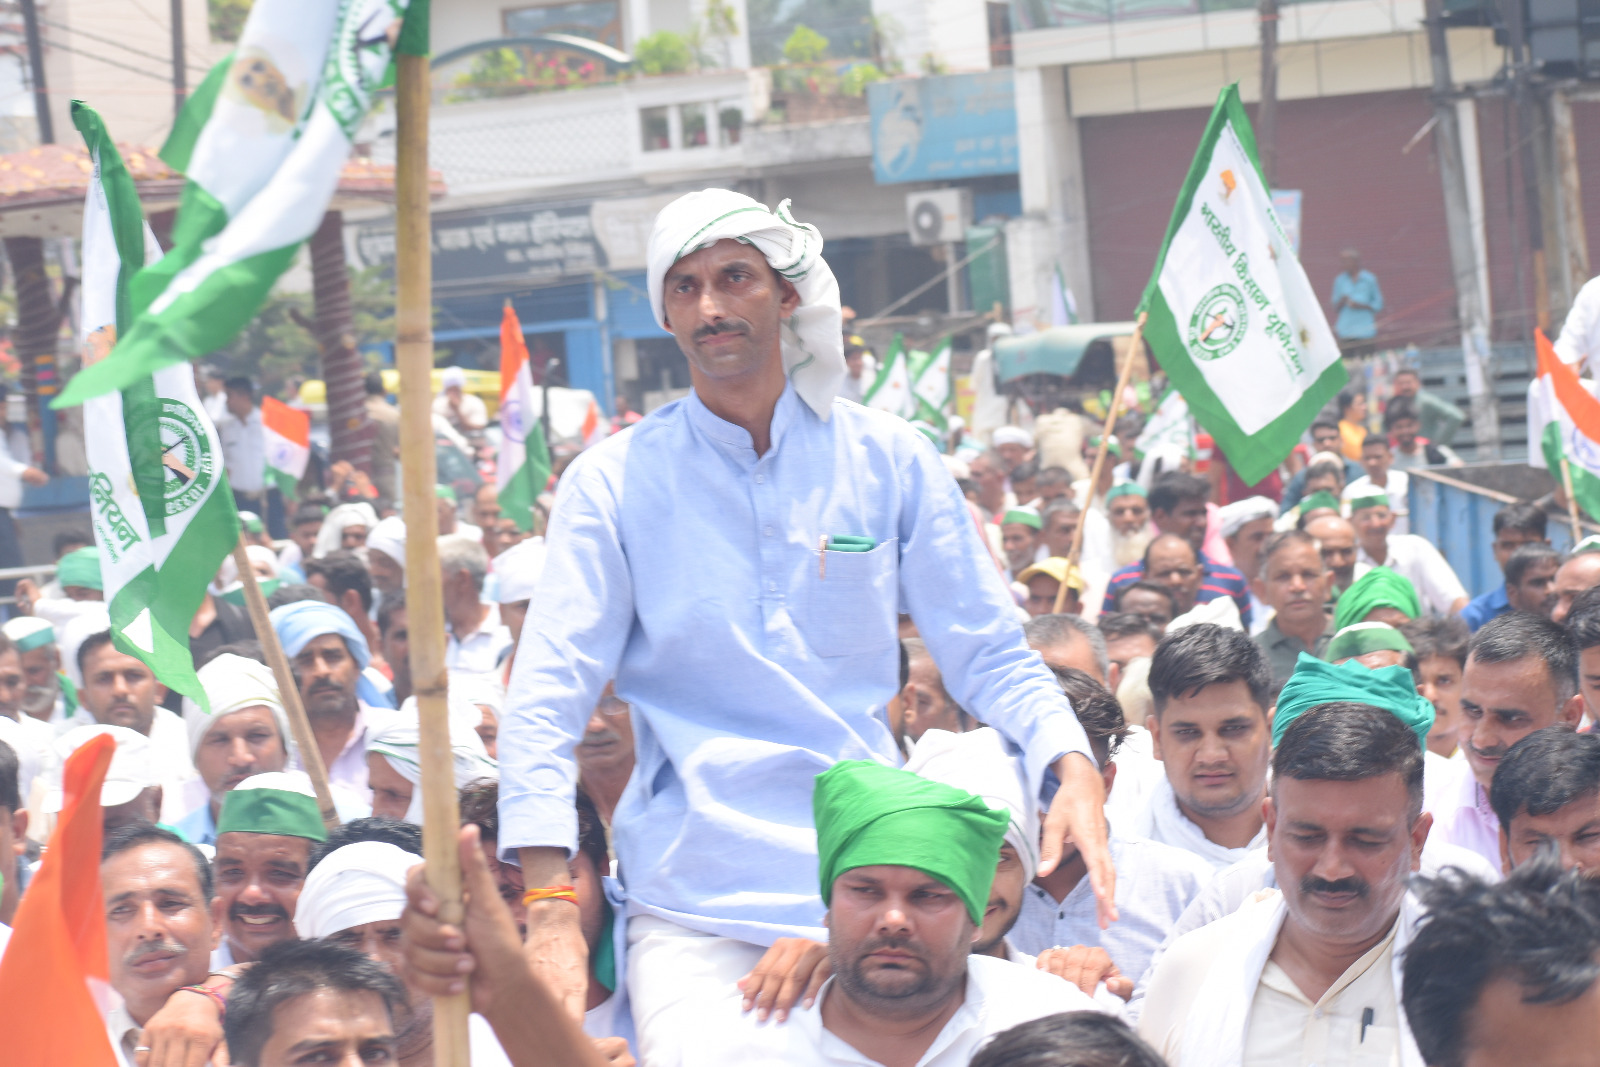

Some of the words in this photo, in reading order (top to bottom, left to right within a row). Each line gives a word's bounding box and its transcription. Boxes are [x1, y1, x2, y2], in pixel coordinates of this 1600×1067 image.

[1201, 202, 1236, 259] भारतीय
[1232, 252, 1271, 311] किसान
[1264, 309, 1304, 376] यूनियन
[89, 471, 142, 552] नियन
